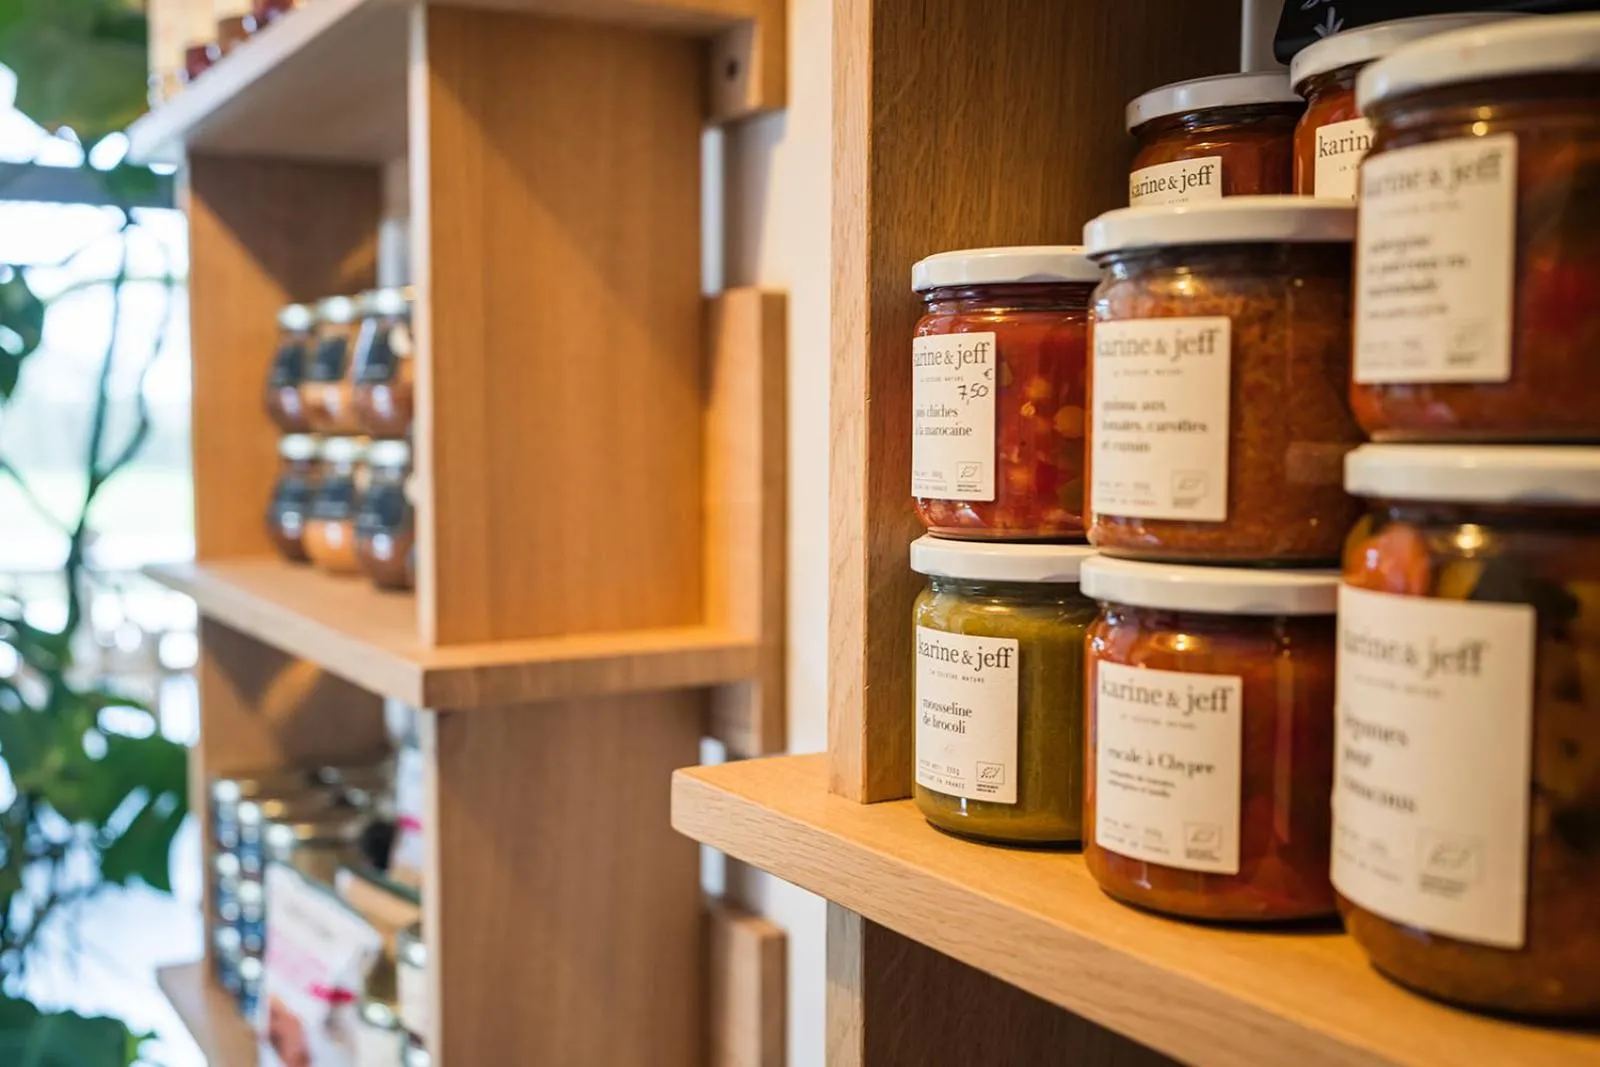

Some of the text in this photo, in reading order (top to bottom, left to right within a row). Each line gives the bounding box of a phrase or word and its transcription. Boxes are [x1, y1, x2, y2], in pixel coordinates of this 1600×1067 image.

[1319, 130, 1371, 158] karin
[1168, 176, 1179, 190] &
[1179, 164, 1215, 194] jeff
[944, 350, 955, 366] &
[955, 341, 991, 370] jeff
[1171, 328, 1222, 362] jeff
[957, 382, 990, 406] 7,50
[917, 632, 1015, 672] karine & jeff
[922, 698, 973, 718] mousseline
[1101, 671, 1163, 705] karine
[1182, 684, 1235, 717] jeff
[932, 714, 966, 734] brocoli
